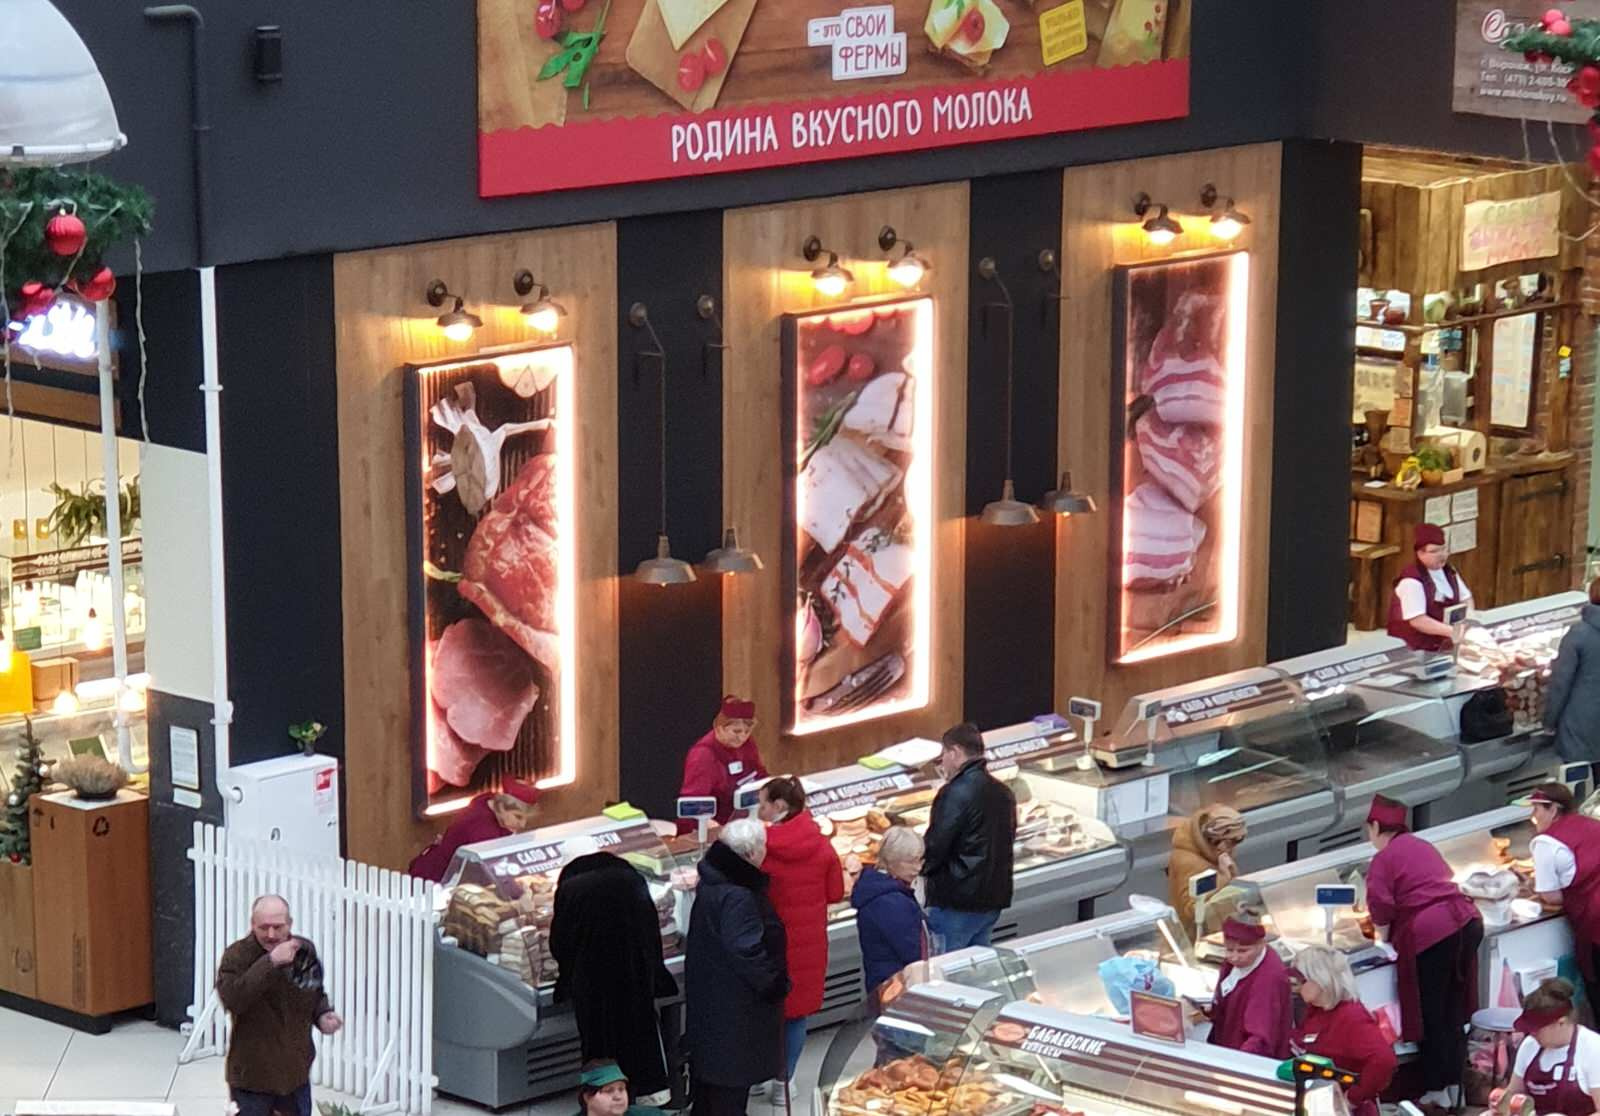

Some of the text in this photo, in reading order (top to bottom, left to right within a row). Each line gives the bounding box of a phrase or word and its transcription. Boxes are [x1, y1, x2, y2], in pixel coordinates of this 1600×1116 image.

[846, 14, 886, 38] СВОИ
[839, 41, 901, 73] ФЕРМЫ
[671, 87, 1033, 163] РОДИНА ВКУСНОГО МОЛОКА
[516, 848, 546, 865] САЛО
